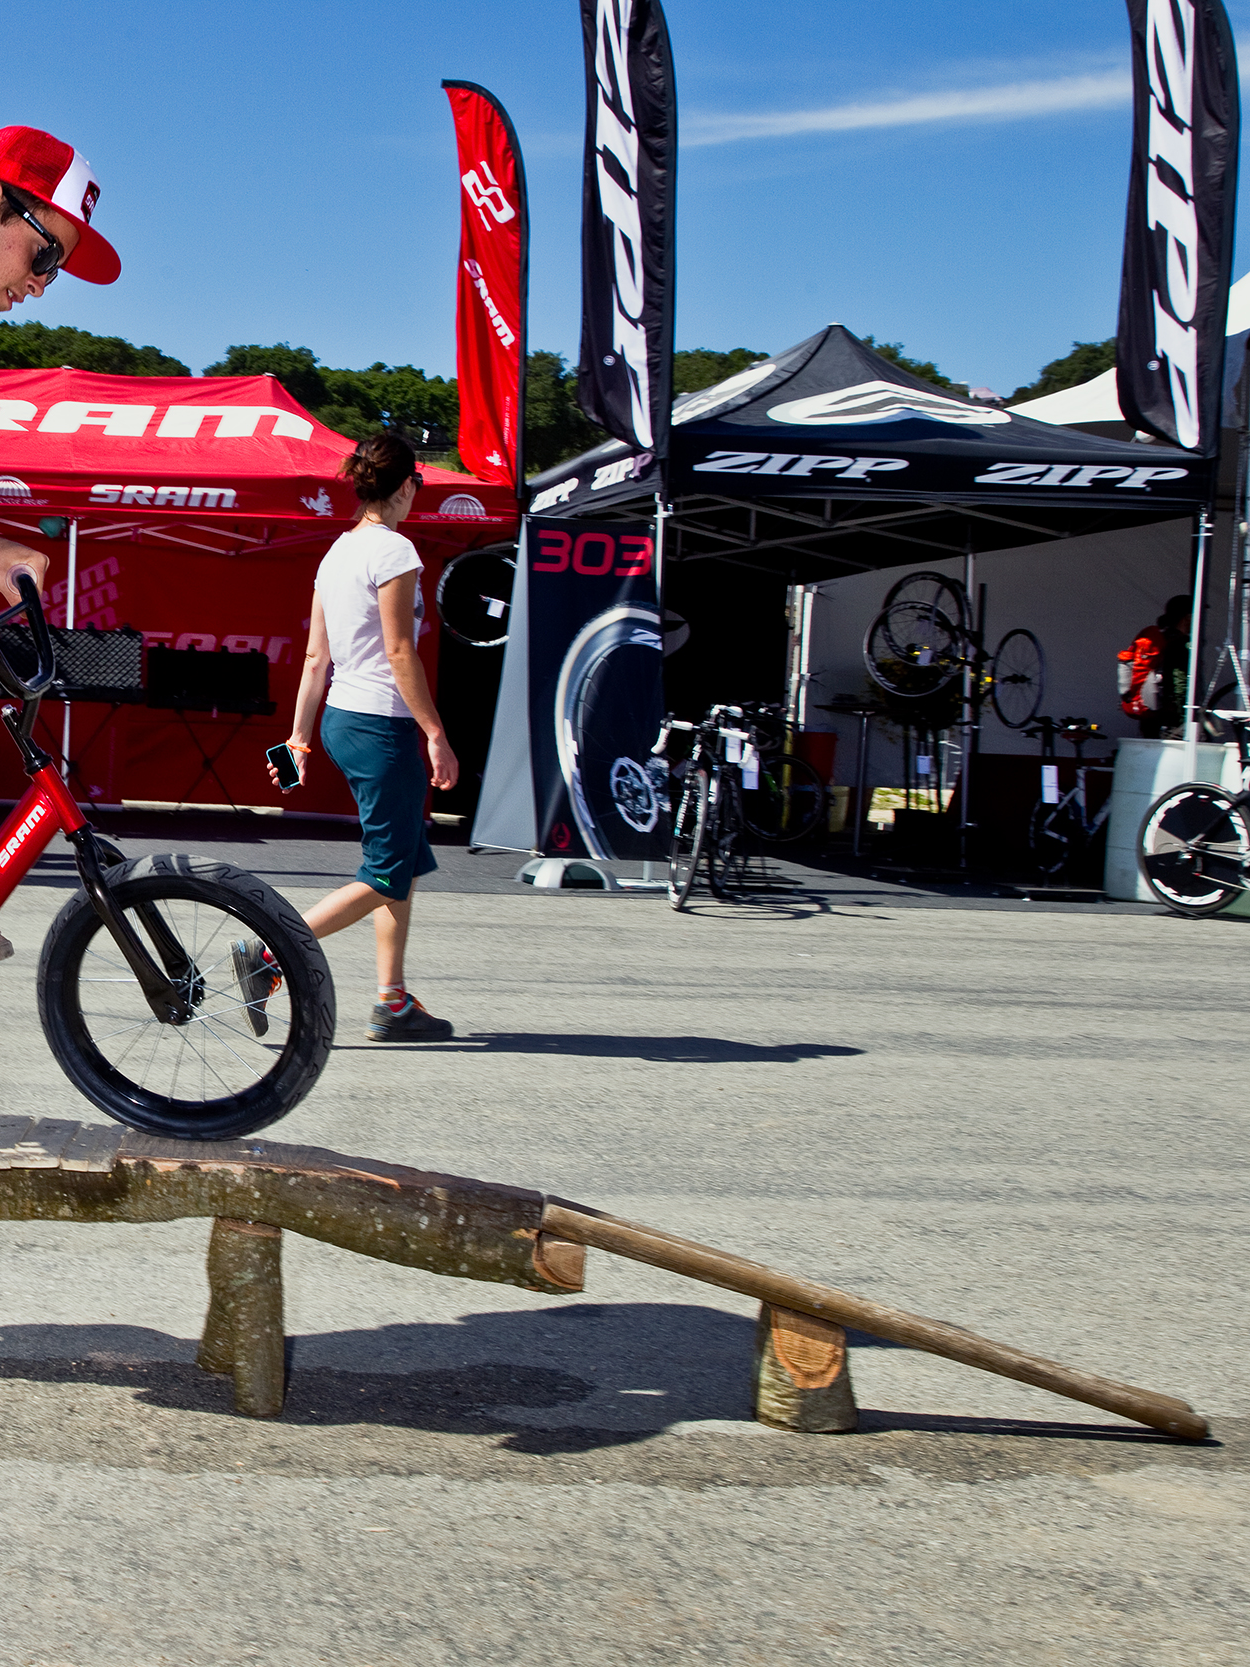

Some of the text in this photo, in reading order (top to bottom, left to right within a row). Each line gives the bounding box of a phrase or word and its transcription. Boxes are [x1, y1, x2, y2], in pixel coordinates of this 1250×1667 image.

[464, 259, 515, 346] SRAM
[591, 453, 652, 491] ZIPP
[693, 451, 909, 479] ZIPP
[975, 463, 1188, 488] ZIPP
[90, 484, 237, 508] SRAM
[530, 477, 579, 513] ZIPP
[533, 529, 654, 577] 303
